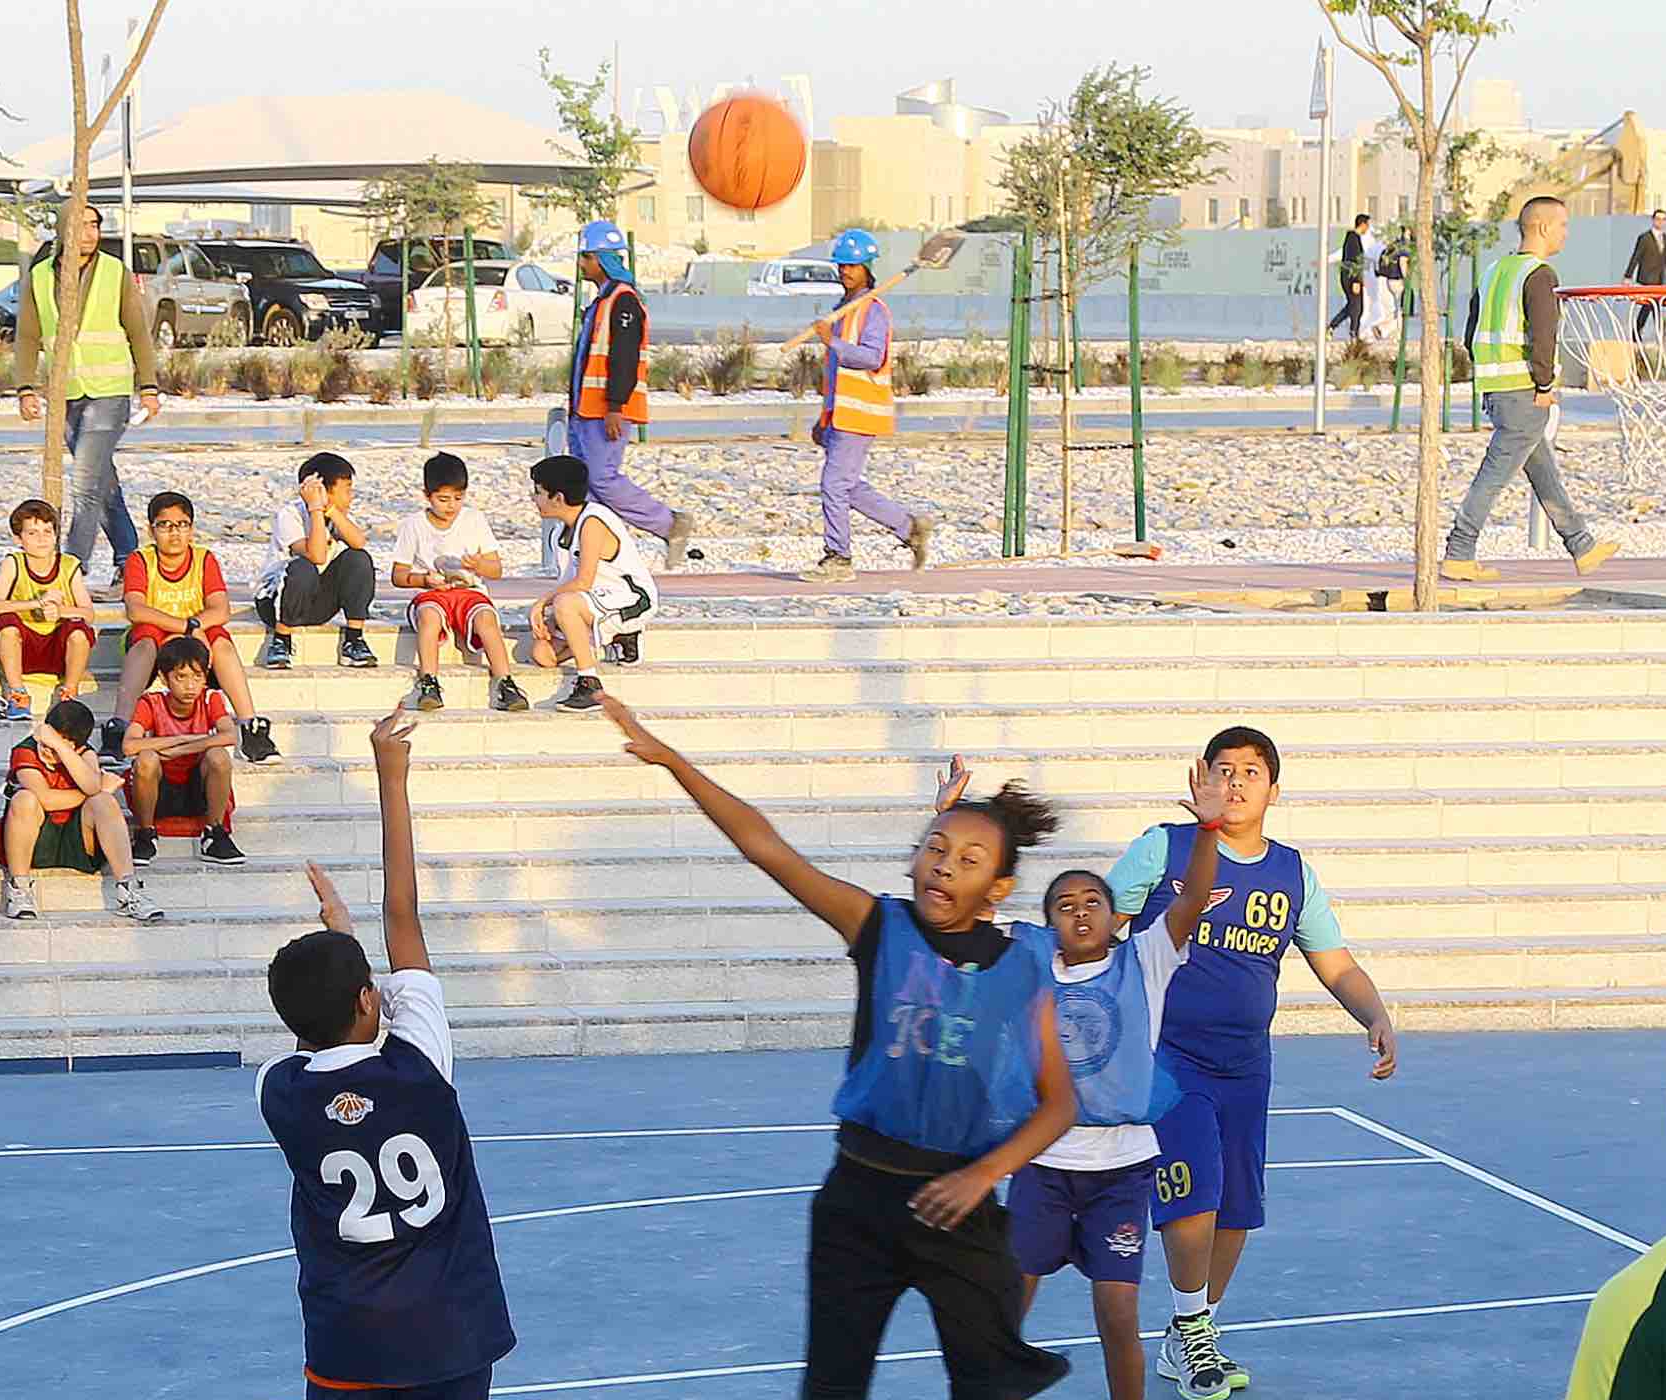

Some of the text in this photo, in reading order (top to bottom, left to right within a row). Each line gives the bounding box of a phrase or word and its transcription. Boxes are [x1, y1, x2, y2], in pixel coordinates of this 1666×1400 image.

[1245, 890, 1290, 931] 69
[320, 1132, 446, 1243] 29
[1155, 1160, 1192, 1204] 69
